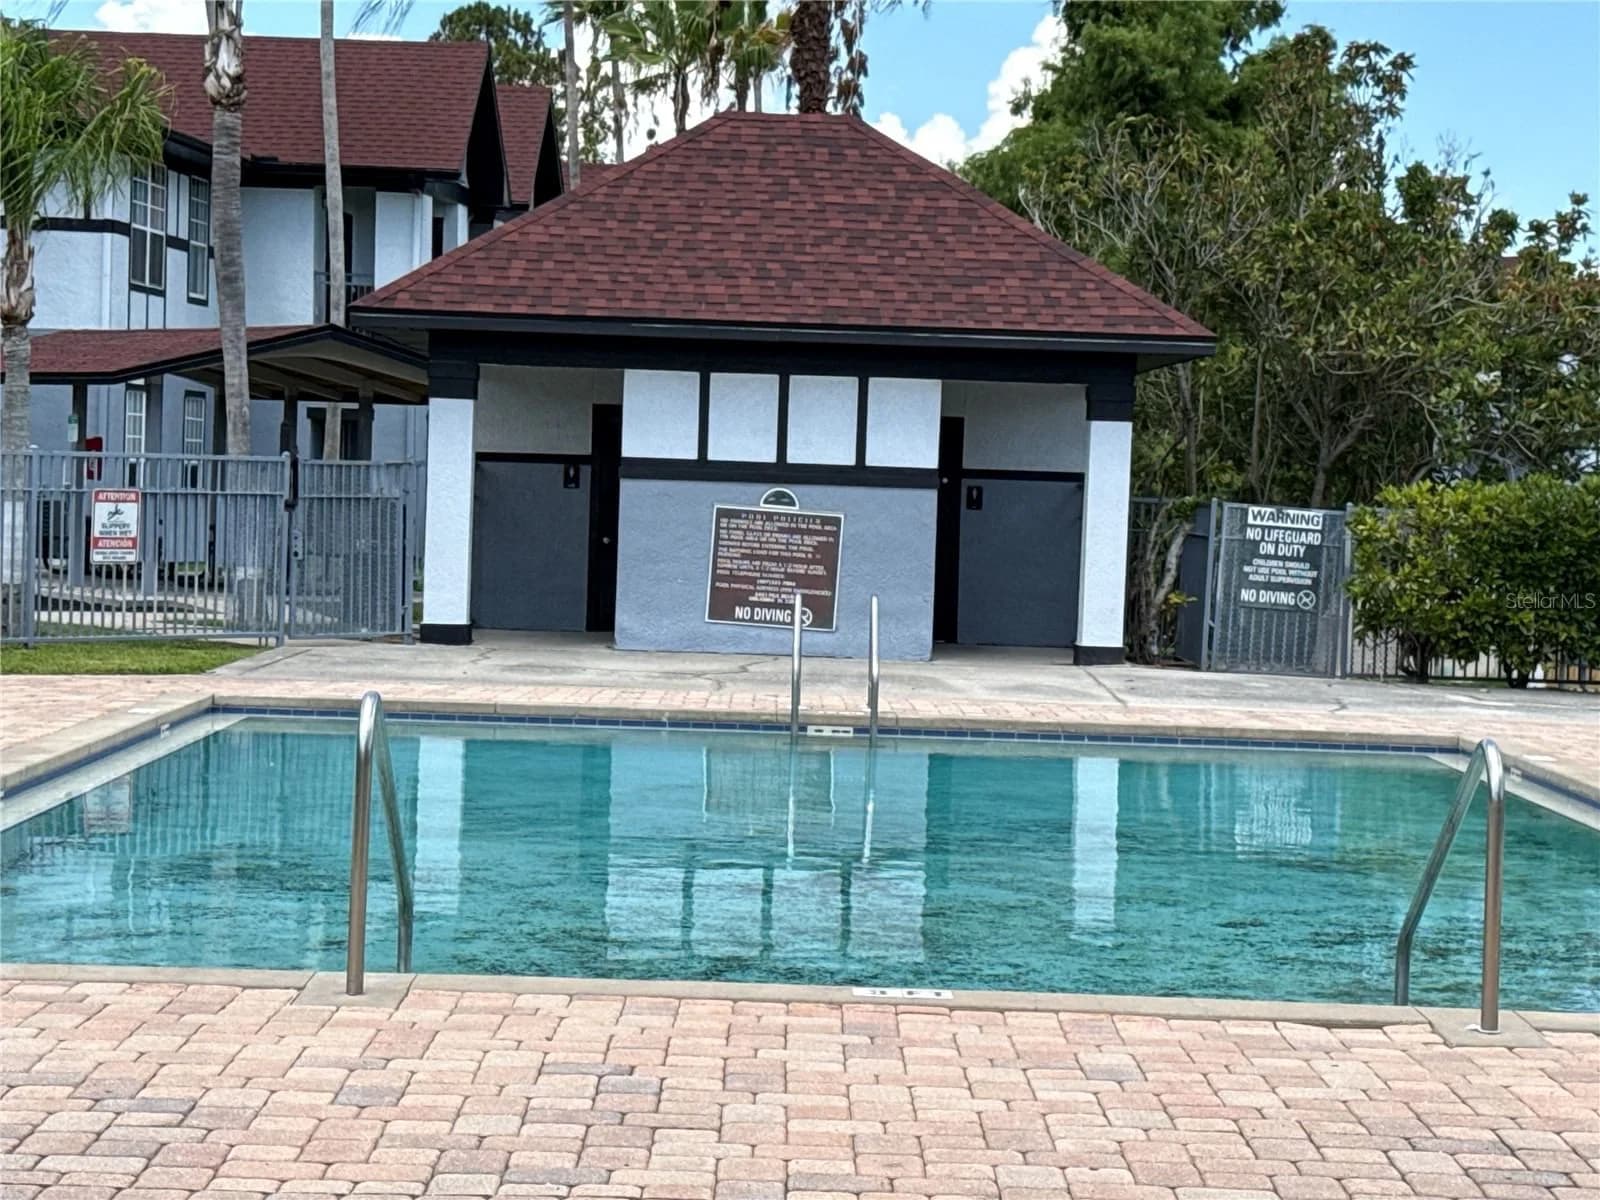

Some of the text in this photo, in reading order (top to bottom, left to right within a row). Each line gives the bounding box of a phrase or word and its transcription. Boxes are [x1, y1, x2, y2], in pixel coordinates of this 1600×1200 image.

[98, 491, 137, 501] ATTENTION
[1251, 508, 1321, 527] WARNING
[1246, 527, 1322, 546] NO LIFEGUARD
[1259, 542, 1306, 558] ON DUTY
[1243, 565, 1318, 578] NOT USE POOL WITHOUT
[1252, 558, 1311, 570] CHILDREN SHOULD
[1248, 574, 1312, 586] ADULT SUPERVISION
[1240, 588, 1296, 606] NO DIVING
[734, 605, 792, 623] NO DIVING
